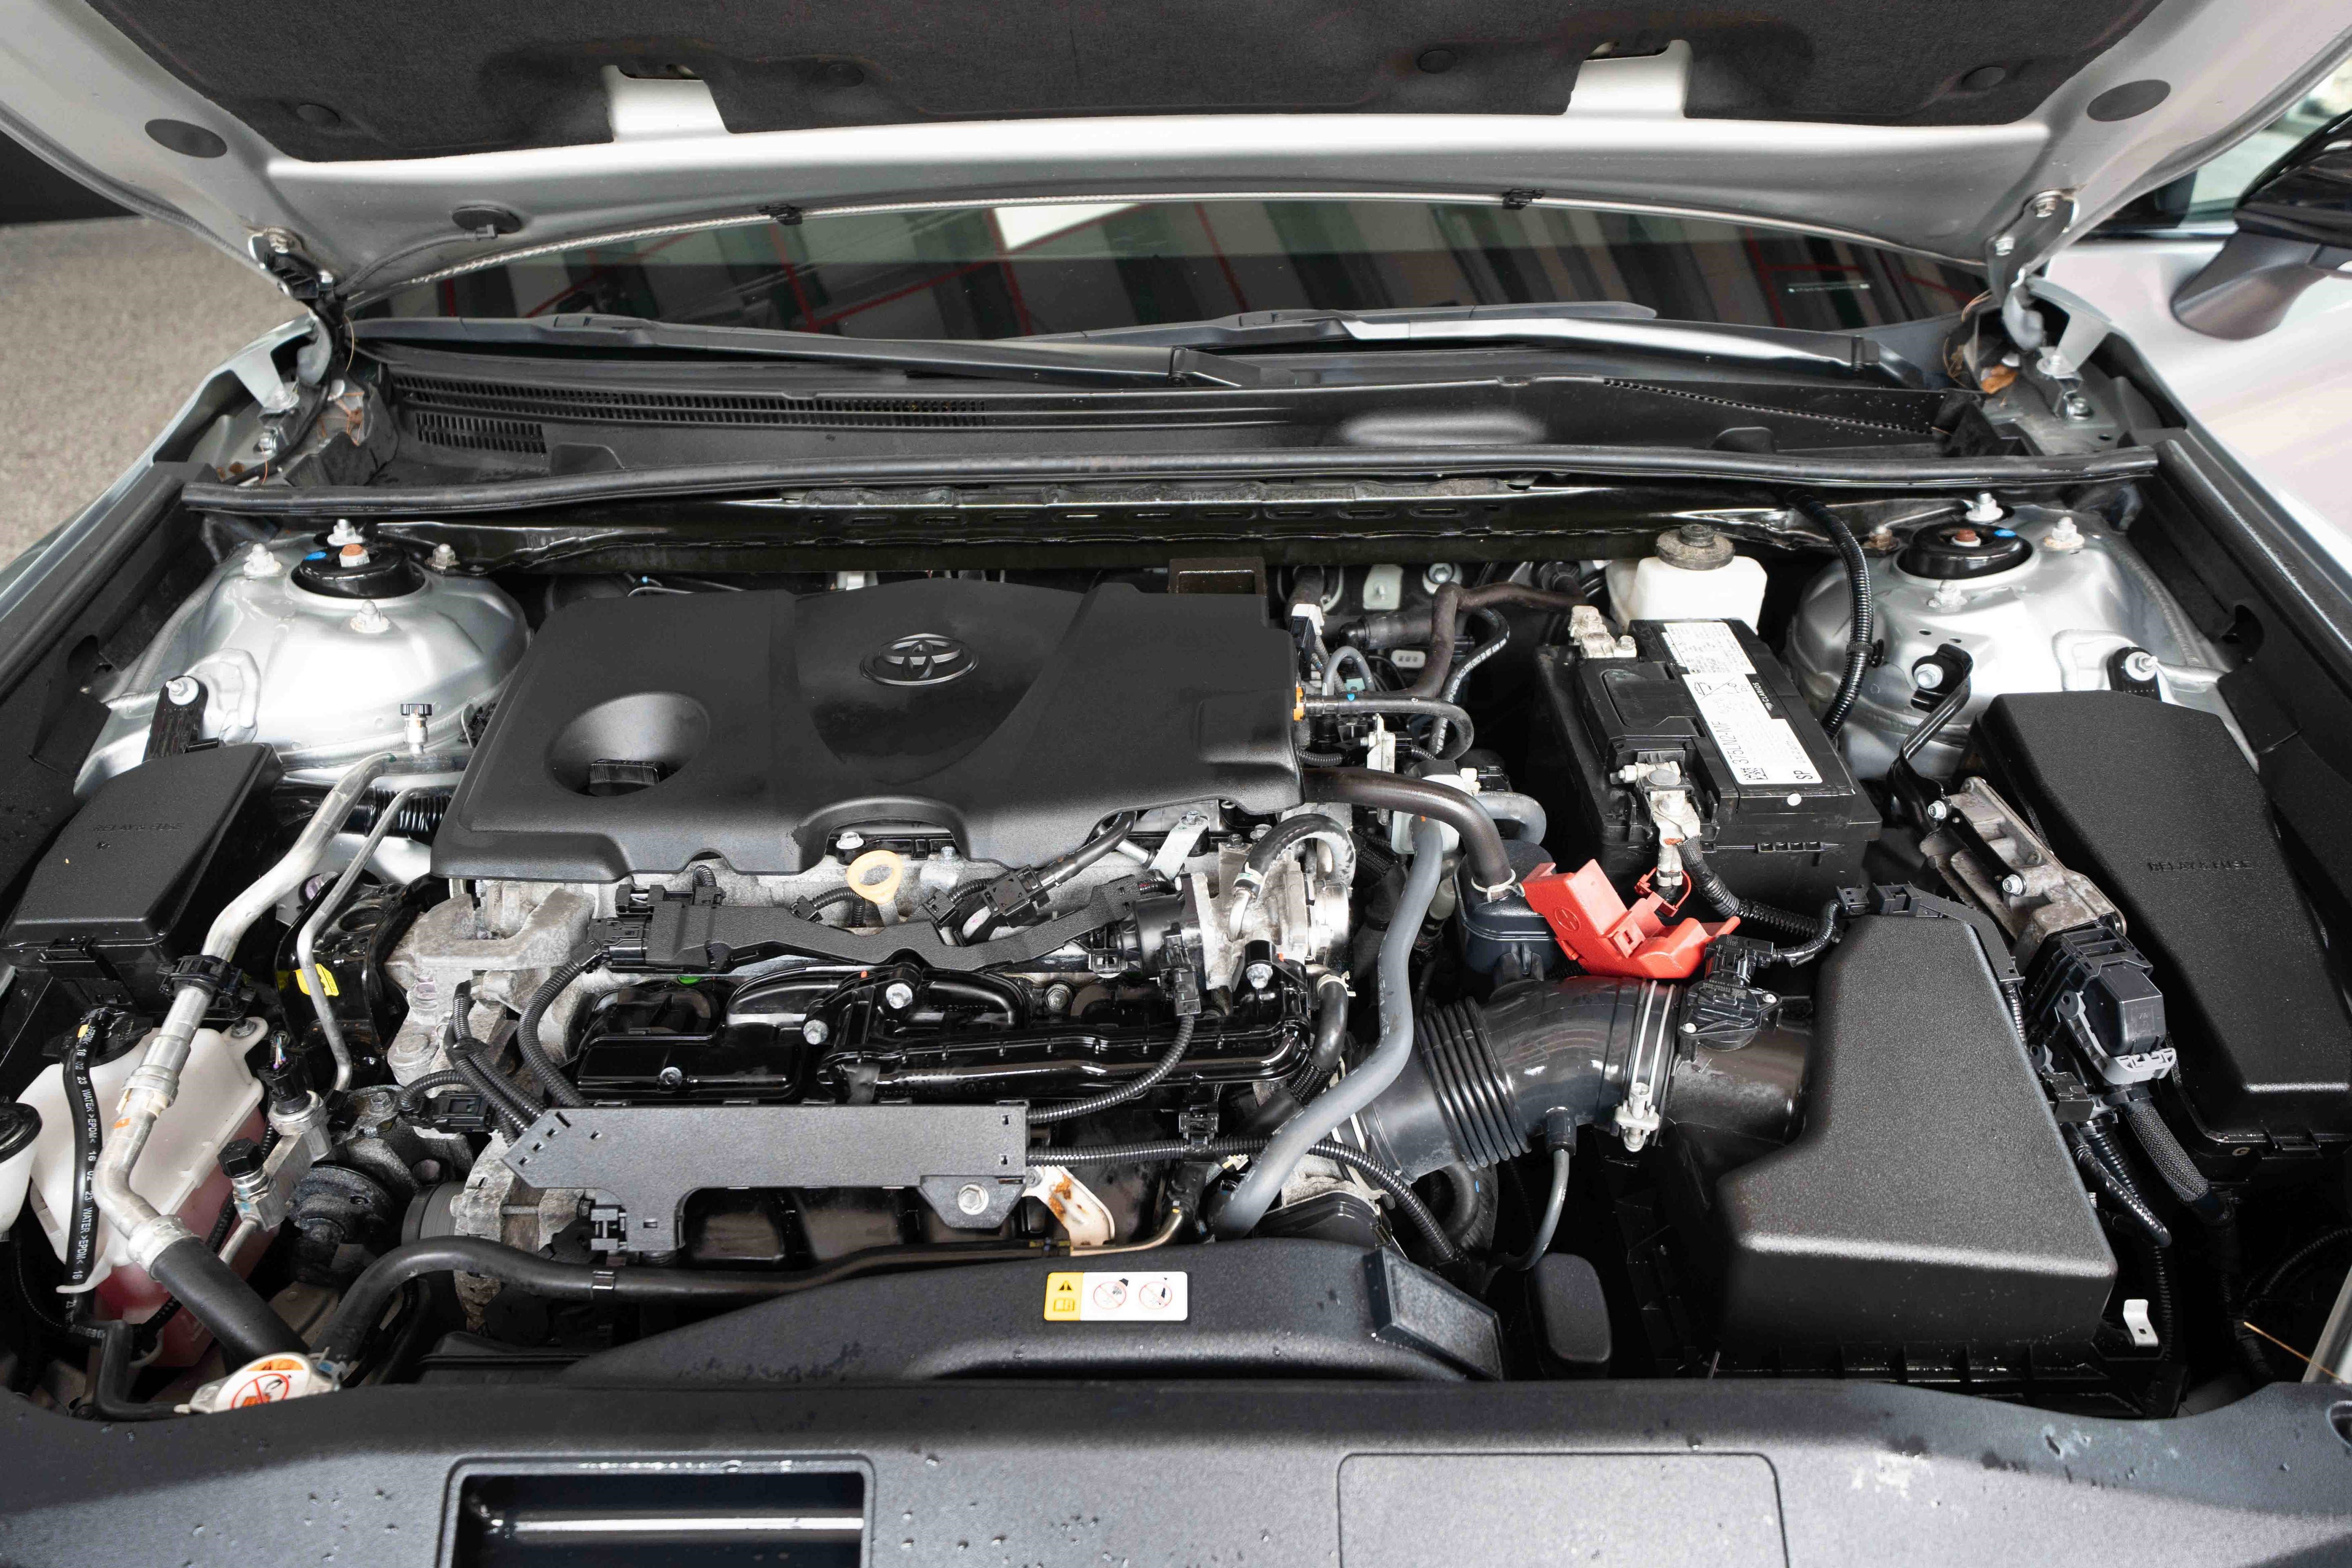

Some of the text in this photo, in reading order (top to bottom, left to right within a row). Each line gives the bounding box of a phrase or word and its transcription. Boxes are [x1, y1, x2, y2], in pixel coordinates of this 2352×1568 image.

[1752, 682, 1769, 702] CLARIOS
[1711, 721, 1749, 764] 375LN2-MF
[1793, 770, 1813, 780] SP
[77, 1076, 87, 1085] 23
[82, 1089, 94, 1112] WATER
[87, 1114, 98, 1143] >EPDM<
[88, 1150, 97, 1161] 16
[2232, 1147, 2250, 1156] G
[81, 1207, 93, 1234] WATER
[76, 1235, 89, 1264] >EPDM<
[72, 1271, 83, 1280] 16
